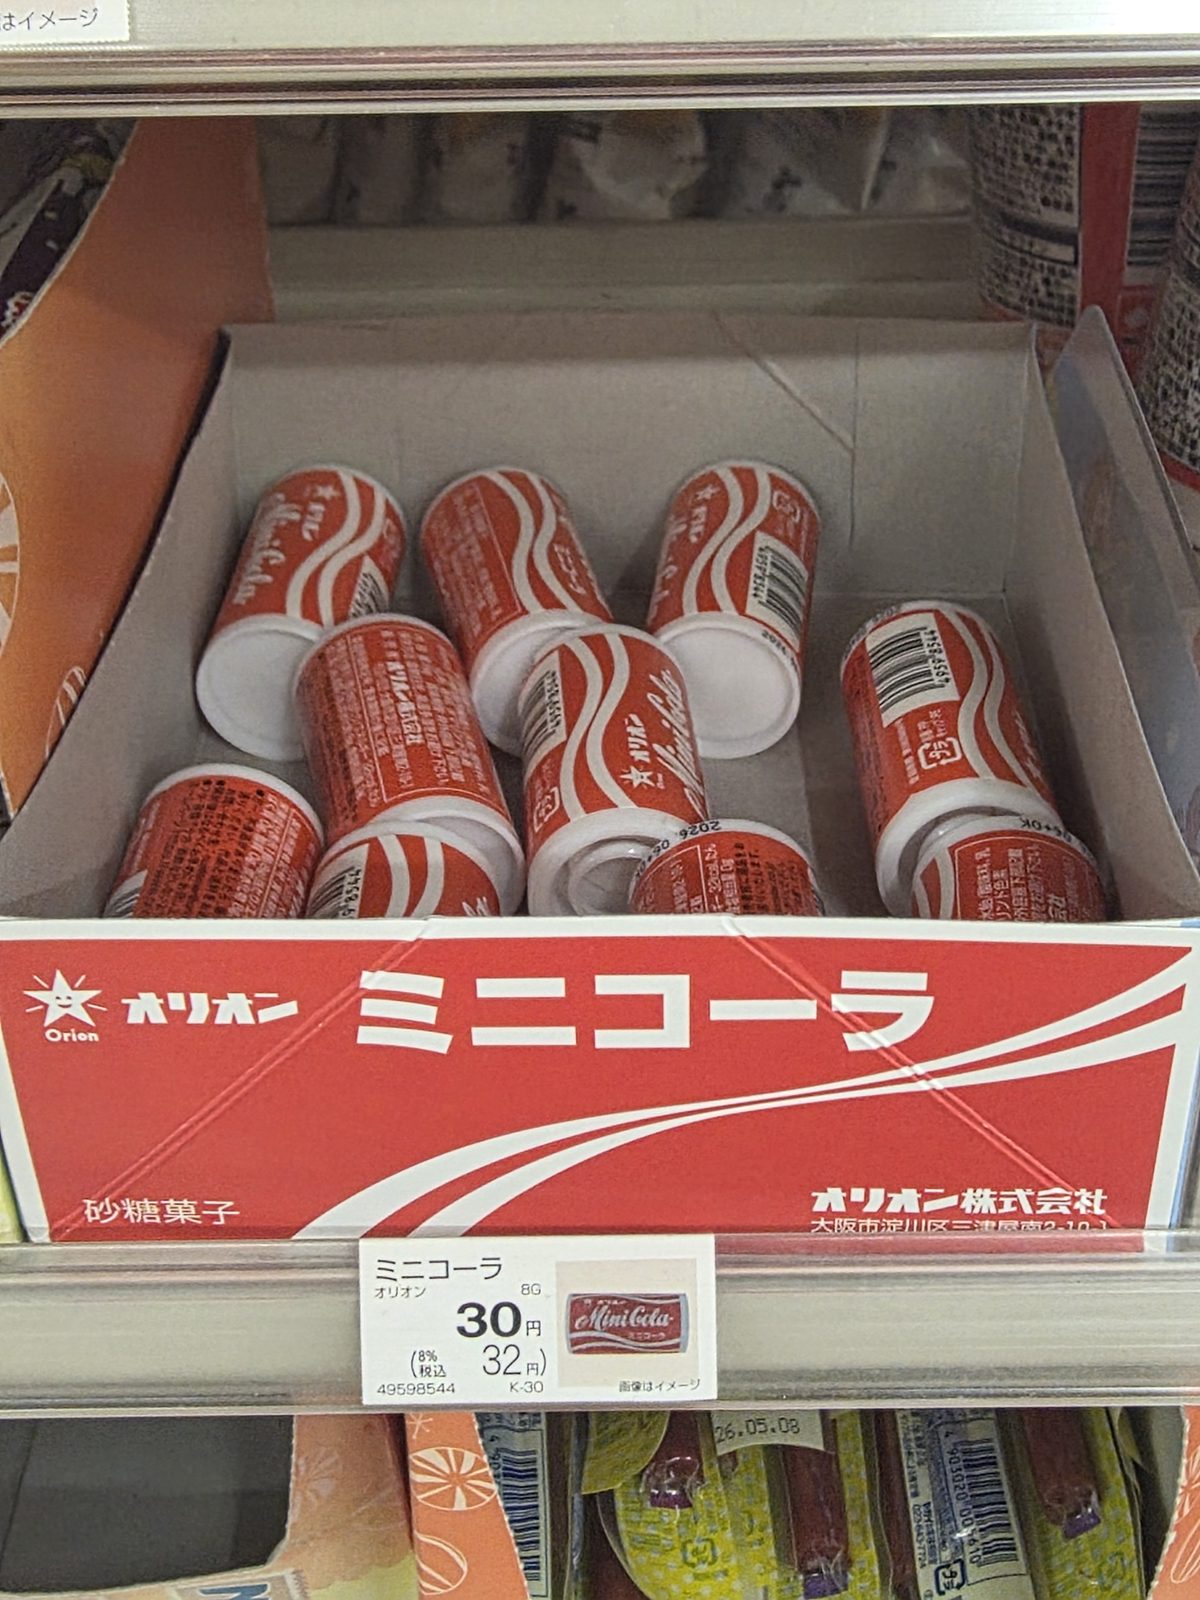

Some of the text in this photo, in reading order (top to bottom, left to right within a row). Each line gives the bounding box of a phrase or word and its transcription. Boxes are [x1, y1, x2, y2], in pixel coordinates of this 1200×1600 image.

[625, 714, 651, 763] オリオン
[121, 970, 936, 1054] オリオン ミニコーラ
[45, 1029, 99, 1042] Orion
[83, 1197, 240, 1225] 砂糖菓子
[811, 1187, 1108, 1215] オリオン株式会社
[376, 1257, 503, 1282] ミニコーラ
[374, 1283, 542, 1299] オリオン 8G
[419, 1364, 447, 1378] 税込
[377, 1381, 544, 1396] 49598544 K-30
[618, 1379, 701, 1393] 画像はイメージ
[713, 1417, 801, 1443] 26.05.08
